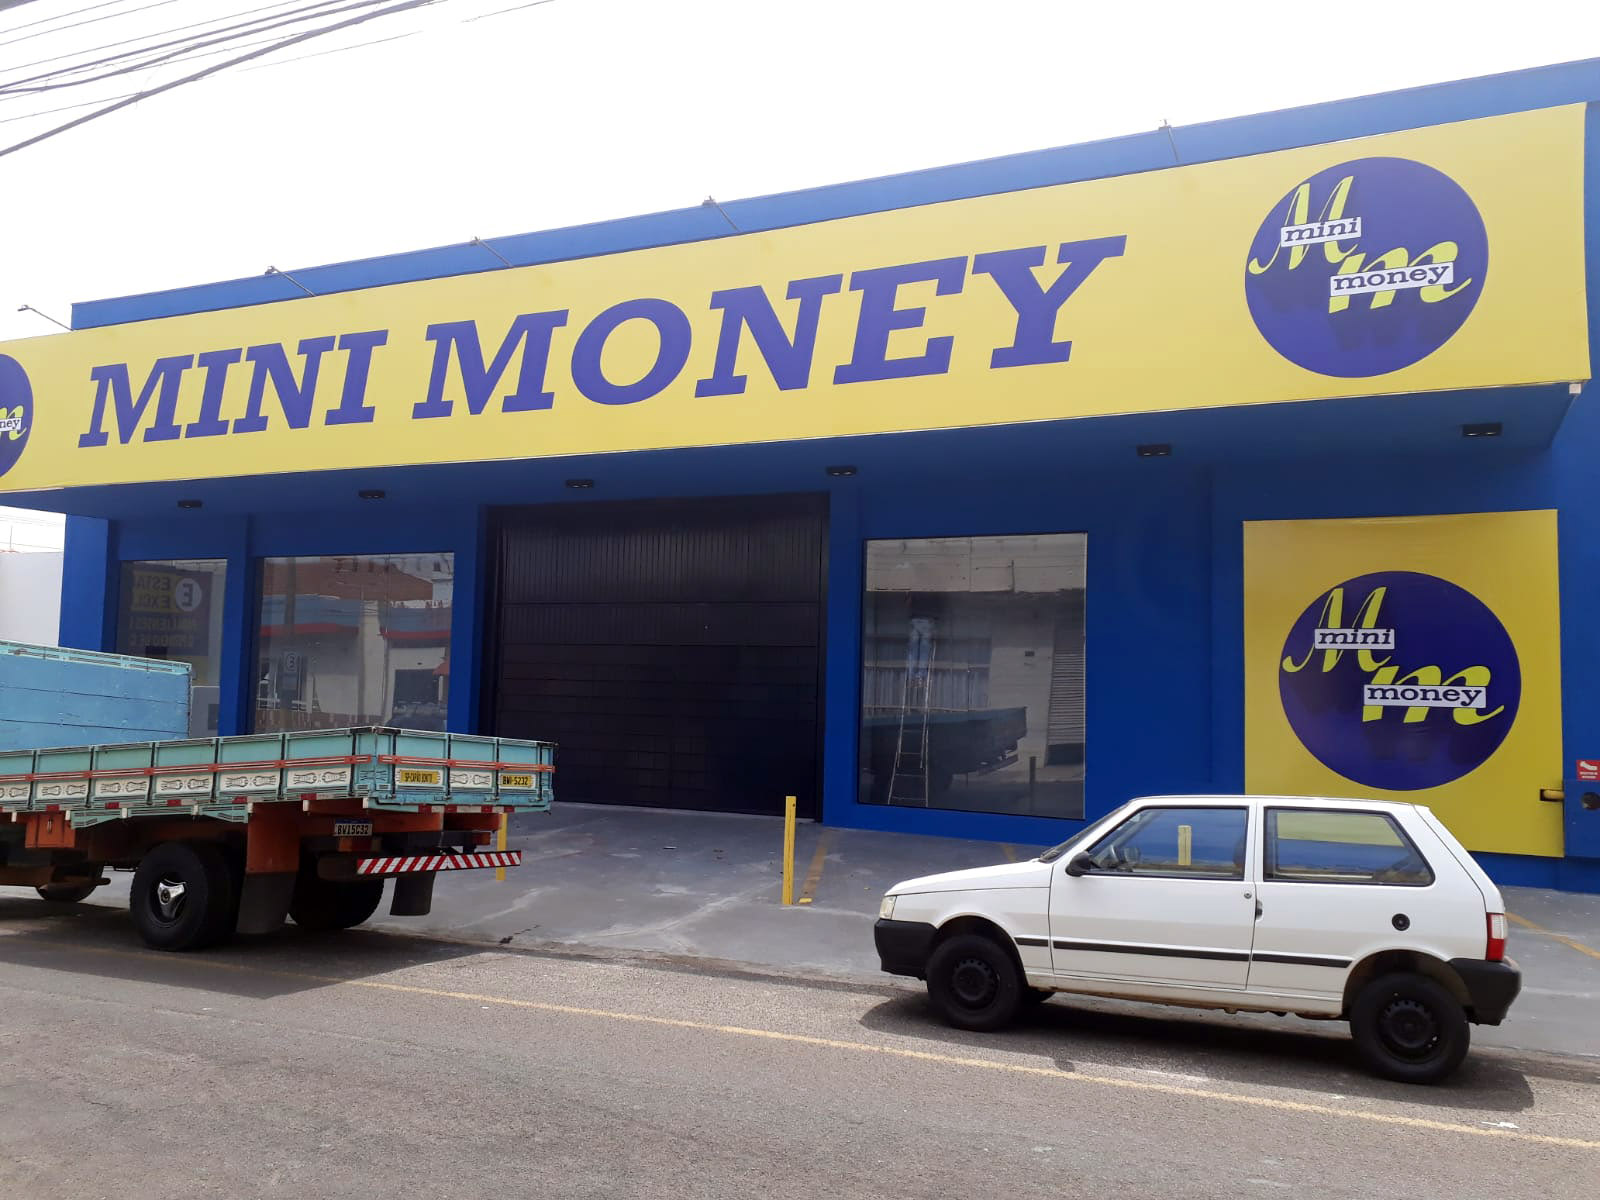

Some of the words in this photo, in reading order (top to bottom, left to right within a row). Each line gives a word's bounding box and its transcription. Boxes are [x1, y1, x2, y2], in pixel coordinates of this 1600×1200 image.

[1284, 217, 1360, 242] mini
[1334, 264, 1450, 291] money
[78, 329, 388, 448] MINI
[412, 235, 1127, 419] MONEY
[1318, 629, 1392, 645] mini
[1367, 687, 1483, 706] money
